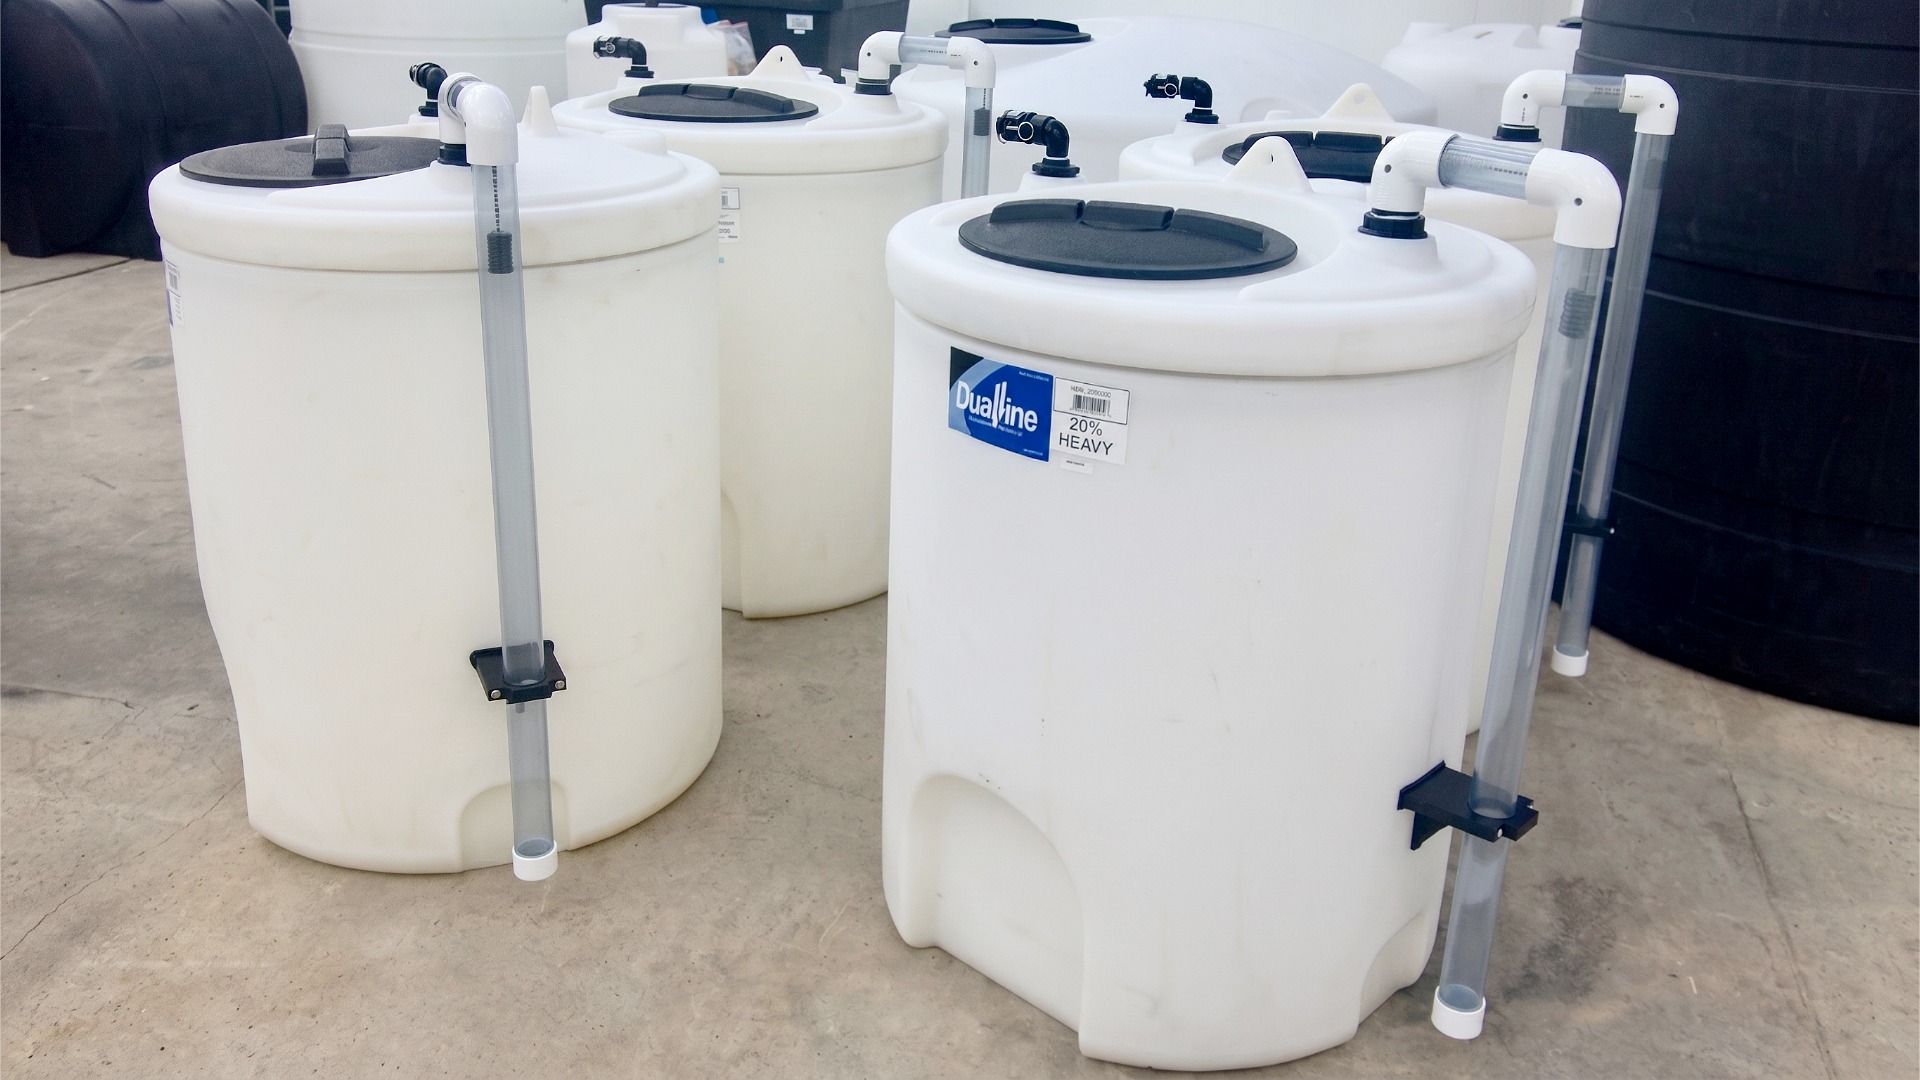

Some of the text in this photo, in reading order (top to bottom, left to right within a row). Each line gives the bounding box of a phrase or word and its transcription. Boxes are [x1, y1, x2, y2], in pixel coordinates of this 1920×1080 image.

[956, 380, 1038, 432] Dualline
[1069, 417, 1103, 436] 20%
[1059, 432, 1113, 455] HEAVY
